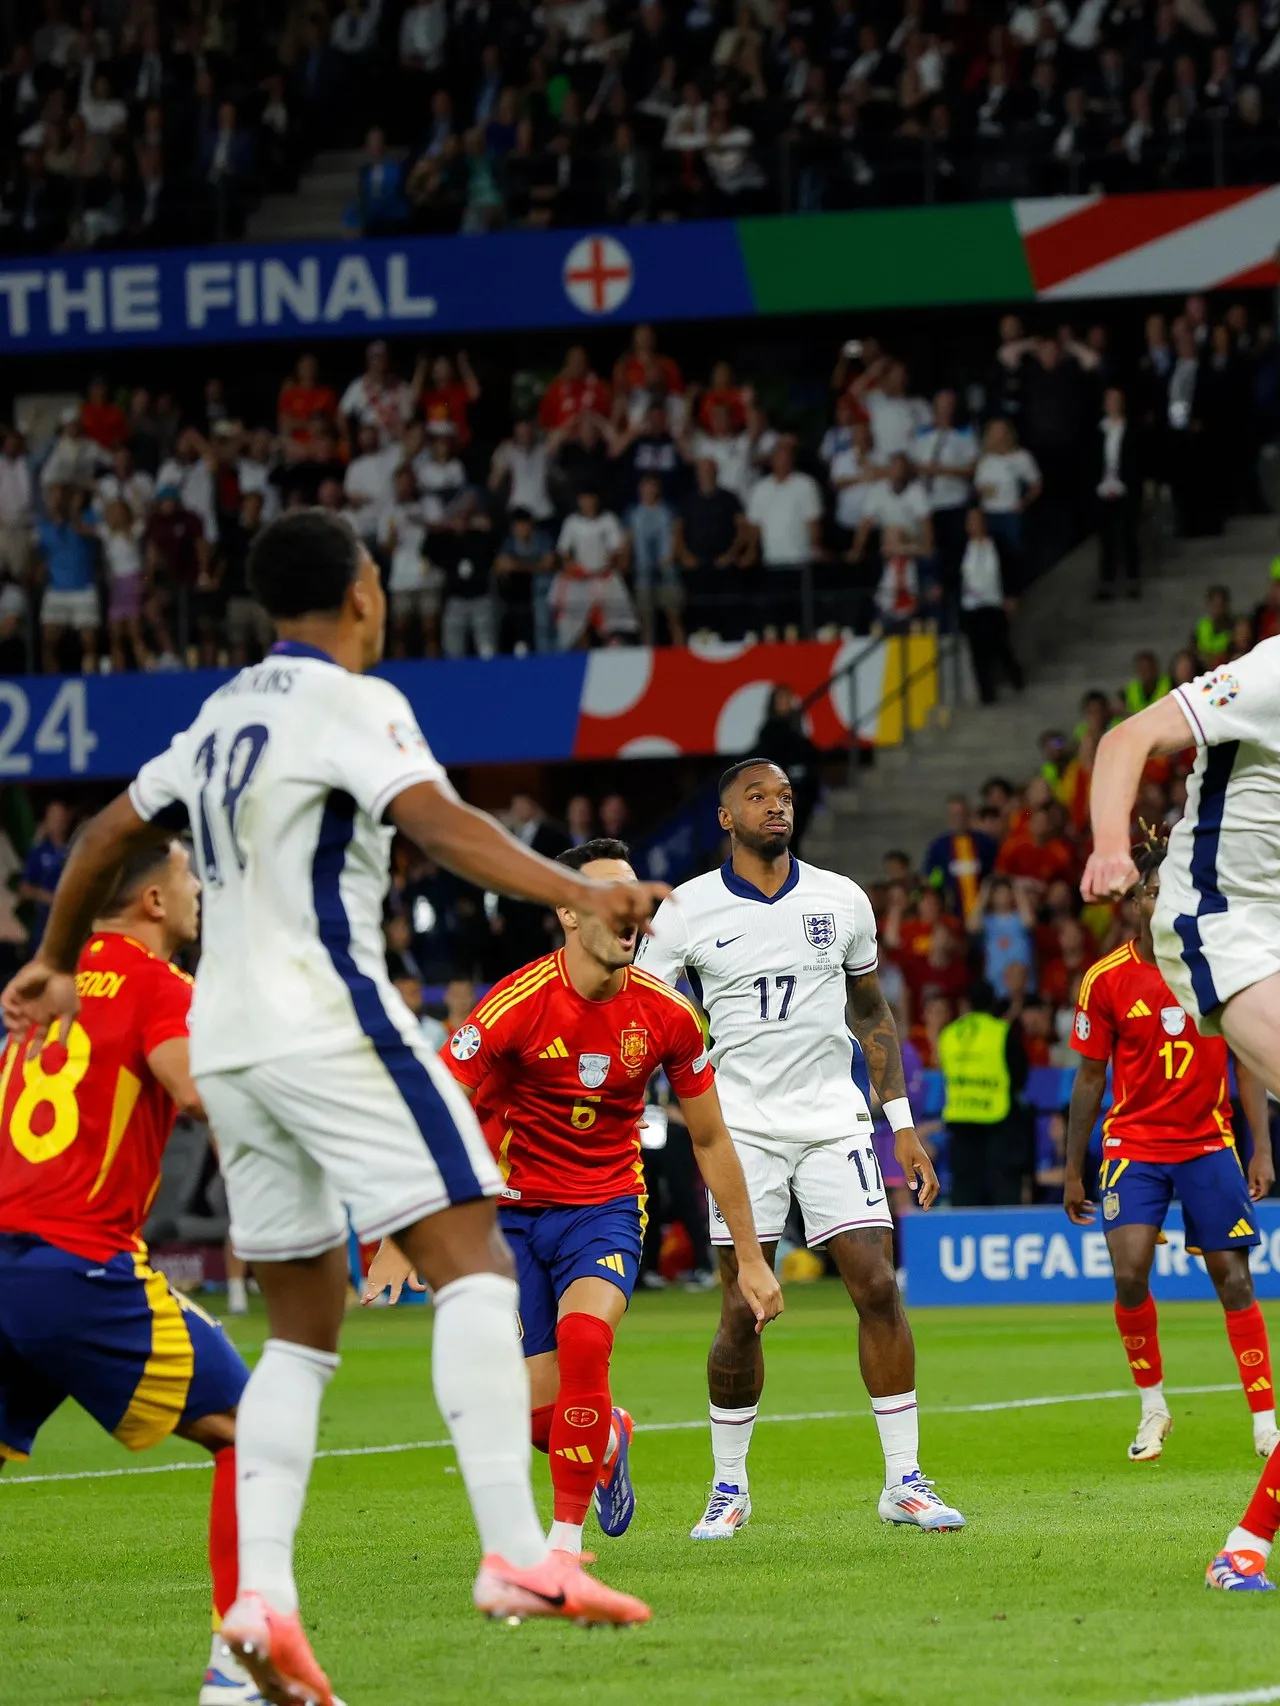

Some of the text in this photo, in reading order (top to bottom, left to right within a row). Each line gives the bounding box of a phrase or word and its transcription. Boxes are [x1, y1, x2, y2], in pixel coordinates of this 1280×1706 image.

[0, 252, 438, 338] THE FINAL
[0, 679, 99, 774] 24
[753, 975, 797, 1021] 17
[1158, 1040, 1195, 1080] 17
[570, 1095, 602, 1130] 6
[847, 1147, 884, 1193] 17
[938, 1232, 1079, 1283] UEFA
